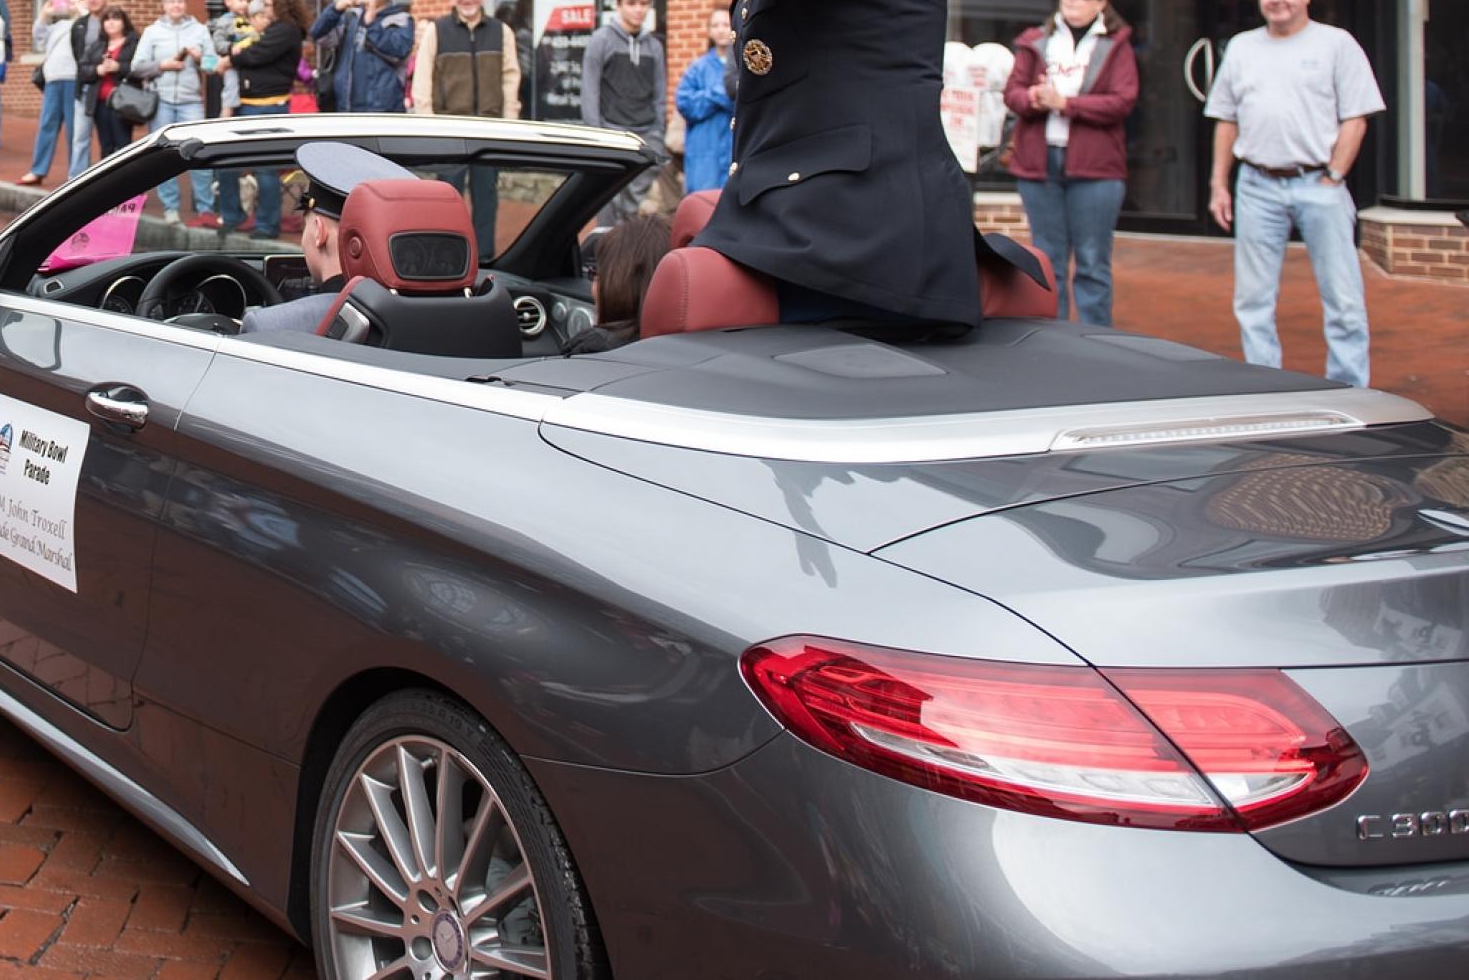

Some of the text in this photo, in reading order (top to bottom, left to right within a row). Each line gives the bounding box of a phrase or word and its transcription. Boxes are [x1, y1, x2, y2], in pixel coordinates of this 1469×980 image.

[561, 7, 592, 24] SALE
[19, 429, 69, 463] Military Bowl
[23, 458, 50, 485] Parade
[6, 499, 29, 523] John
[31, 509, 67, 540] Troxell
[10, 527, 37, 555] Grand
[36, 540, 73, 572] Marshal
